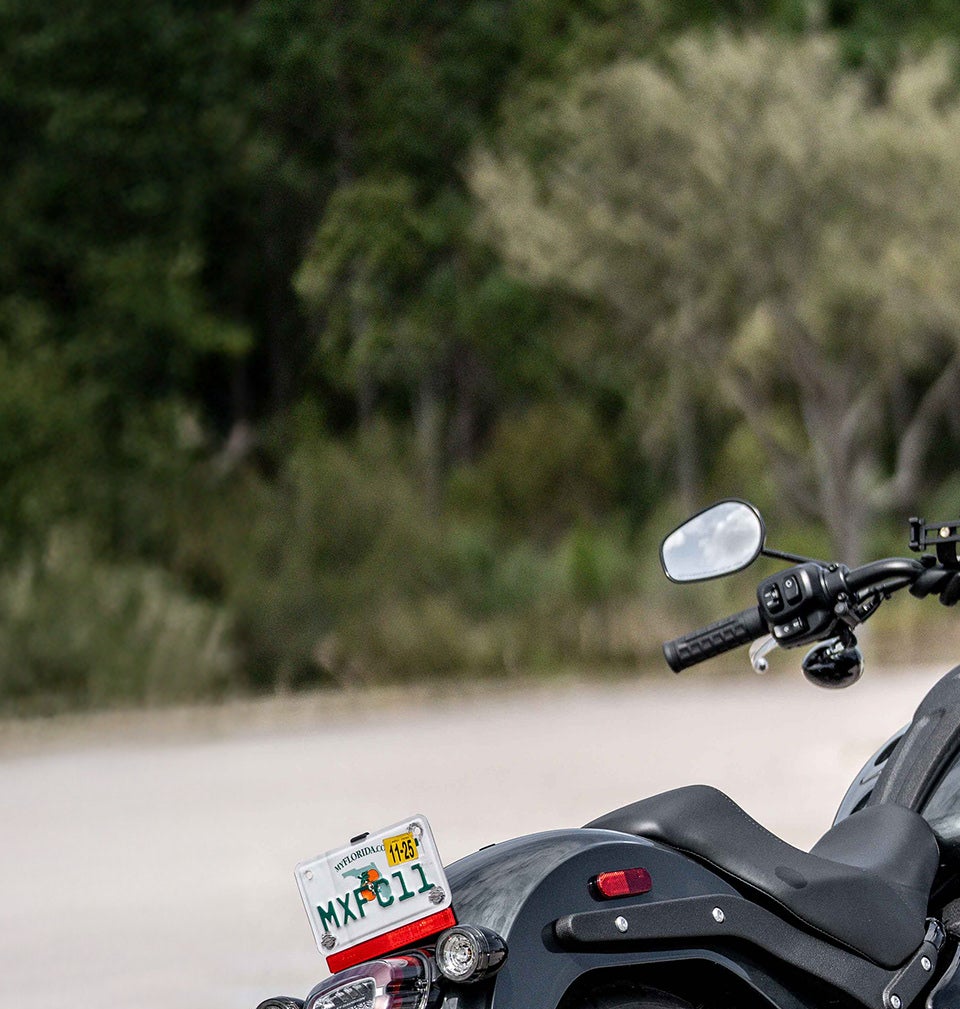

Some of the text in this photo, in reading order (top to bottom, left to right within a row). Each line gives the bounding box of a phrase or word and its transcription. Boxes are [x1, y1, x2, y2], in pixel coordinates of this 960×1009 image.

[334, 845, 386, 872] MYFLORIDA.CO
[389, 840, 415, 863] 11-25
[317, 863, 435, 932] MXFC11
